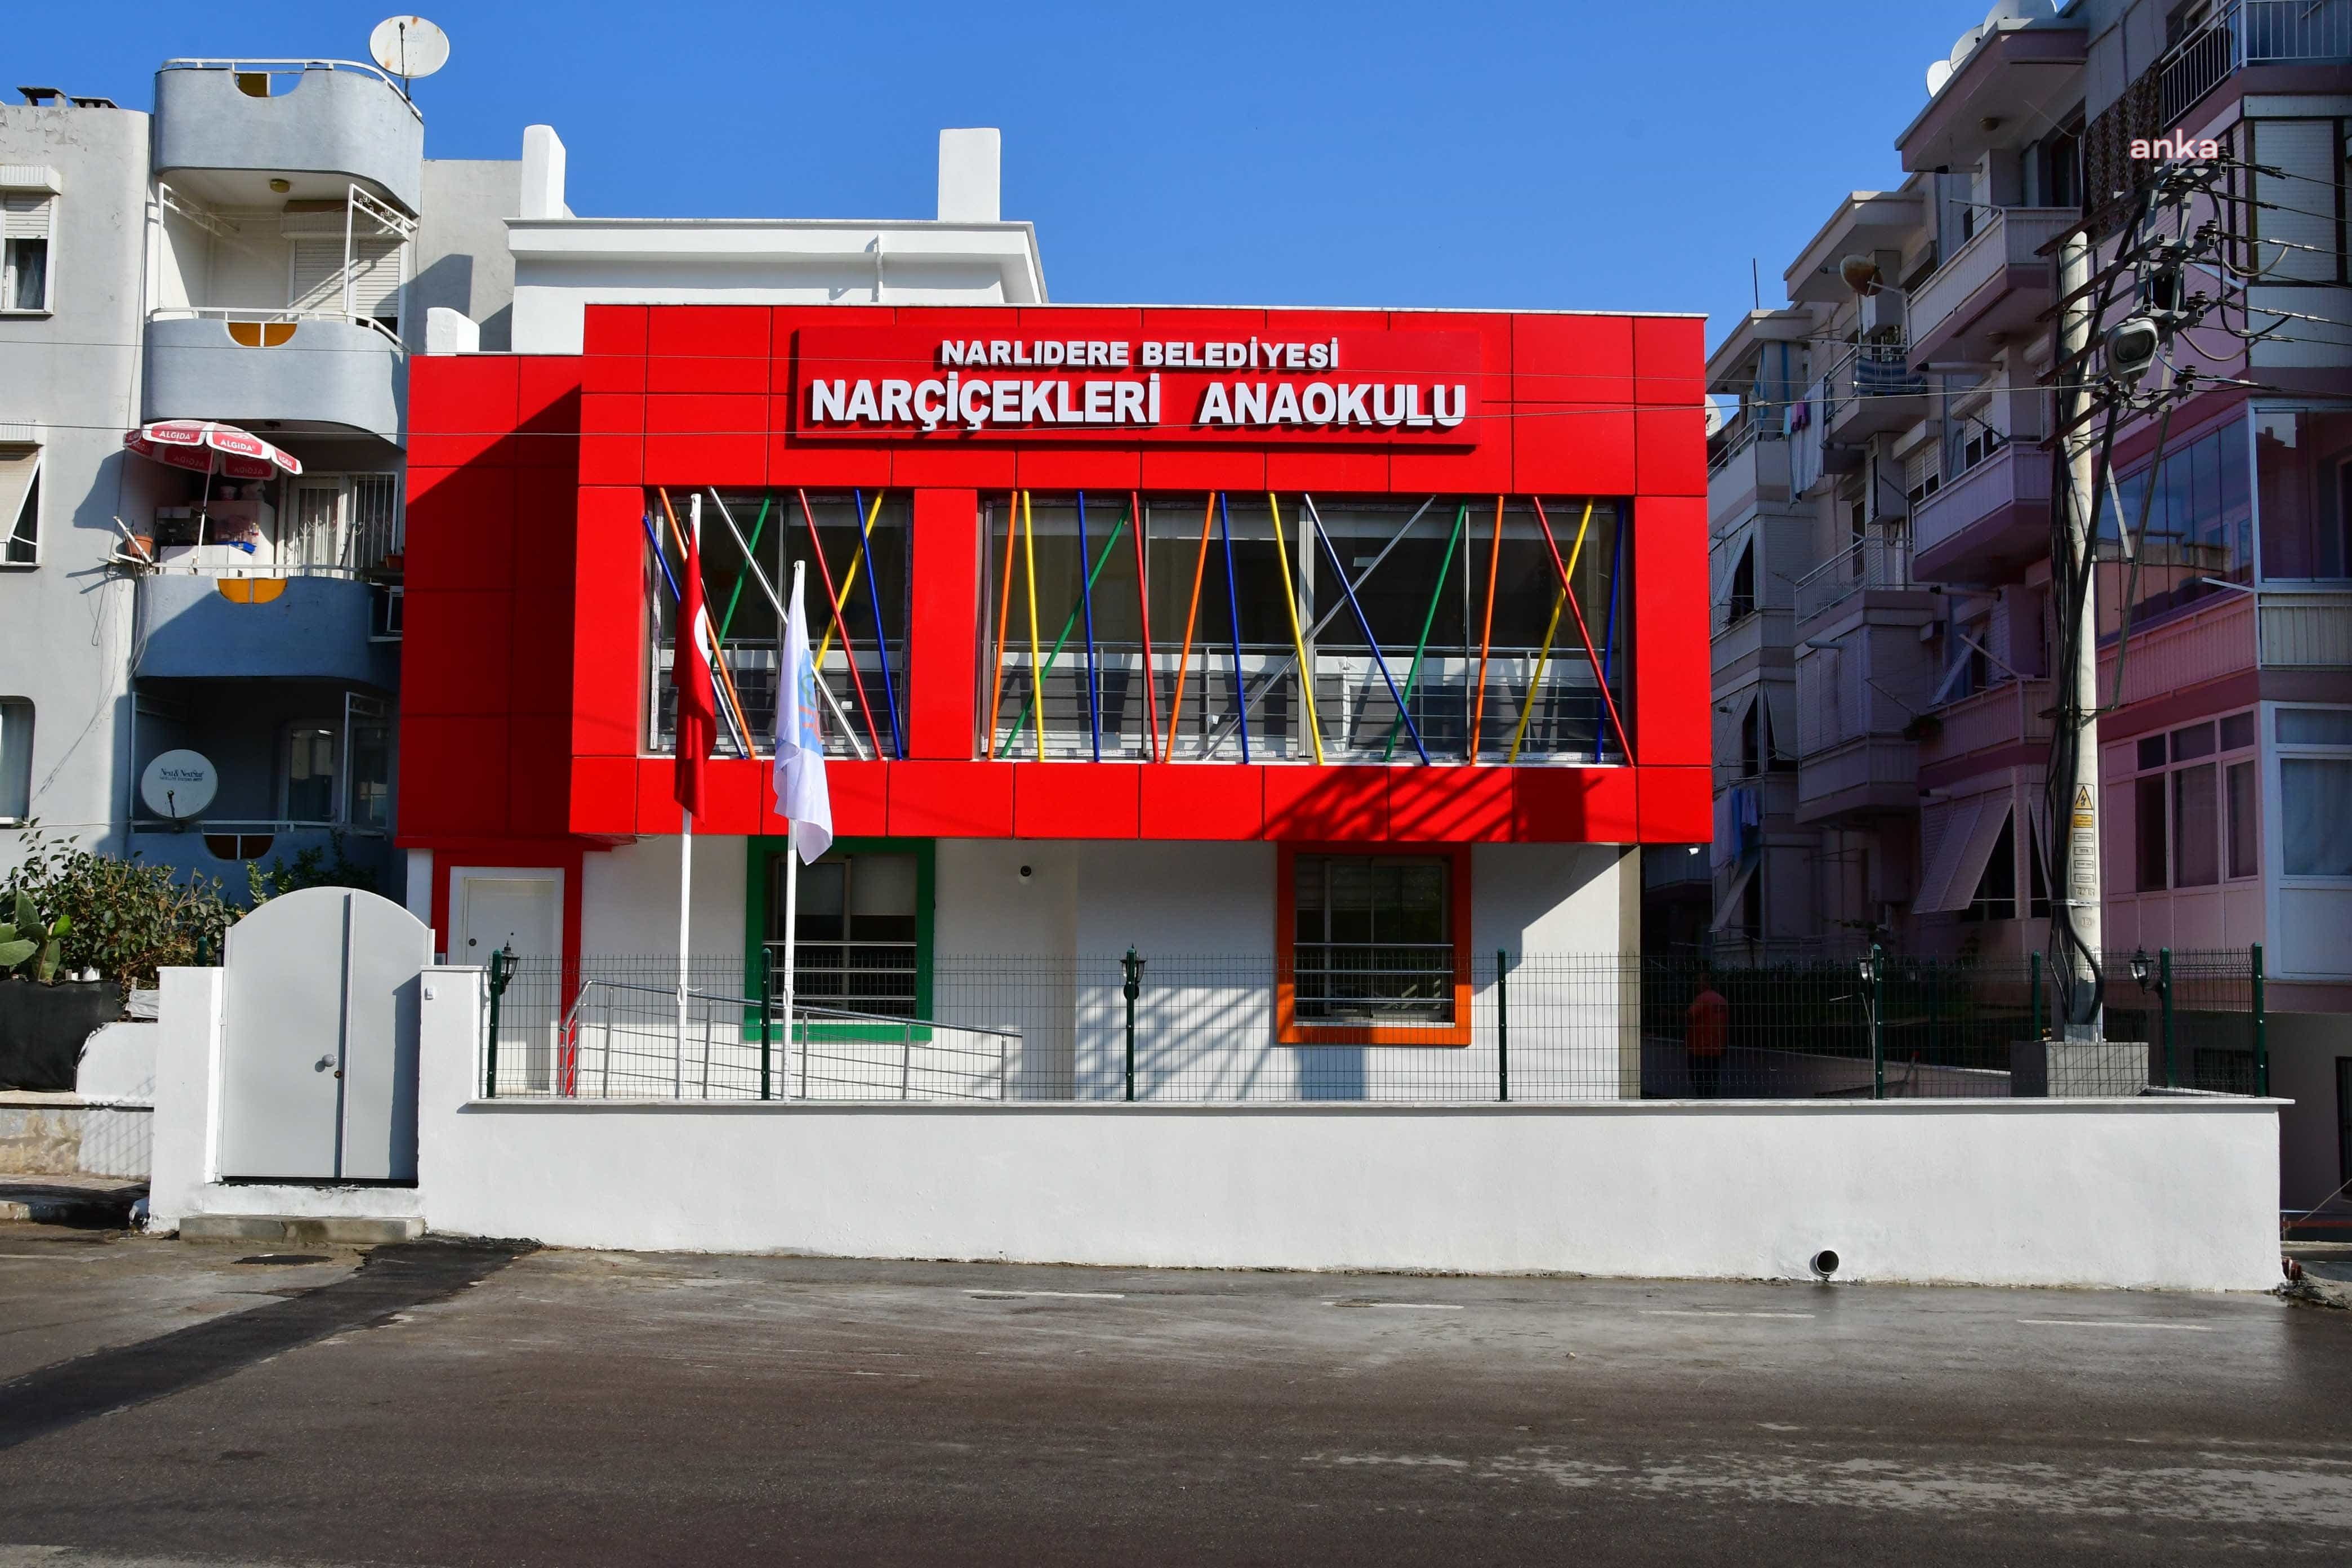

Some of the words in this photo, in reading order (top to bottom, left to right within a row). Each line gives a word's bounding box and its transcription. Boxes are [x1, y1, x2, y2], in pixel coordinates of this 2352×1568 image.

[941, 339, 1129, 368] NARLIDERE
[1141, 336, 1339, 369] BELEDİYESİ
[812, 371, 1161, 431] NARÇİÇEKLERİ
[1198, 382, 1467, 427] ANAOKULU
